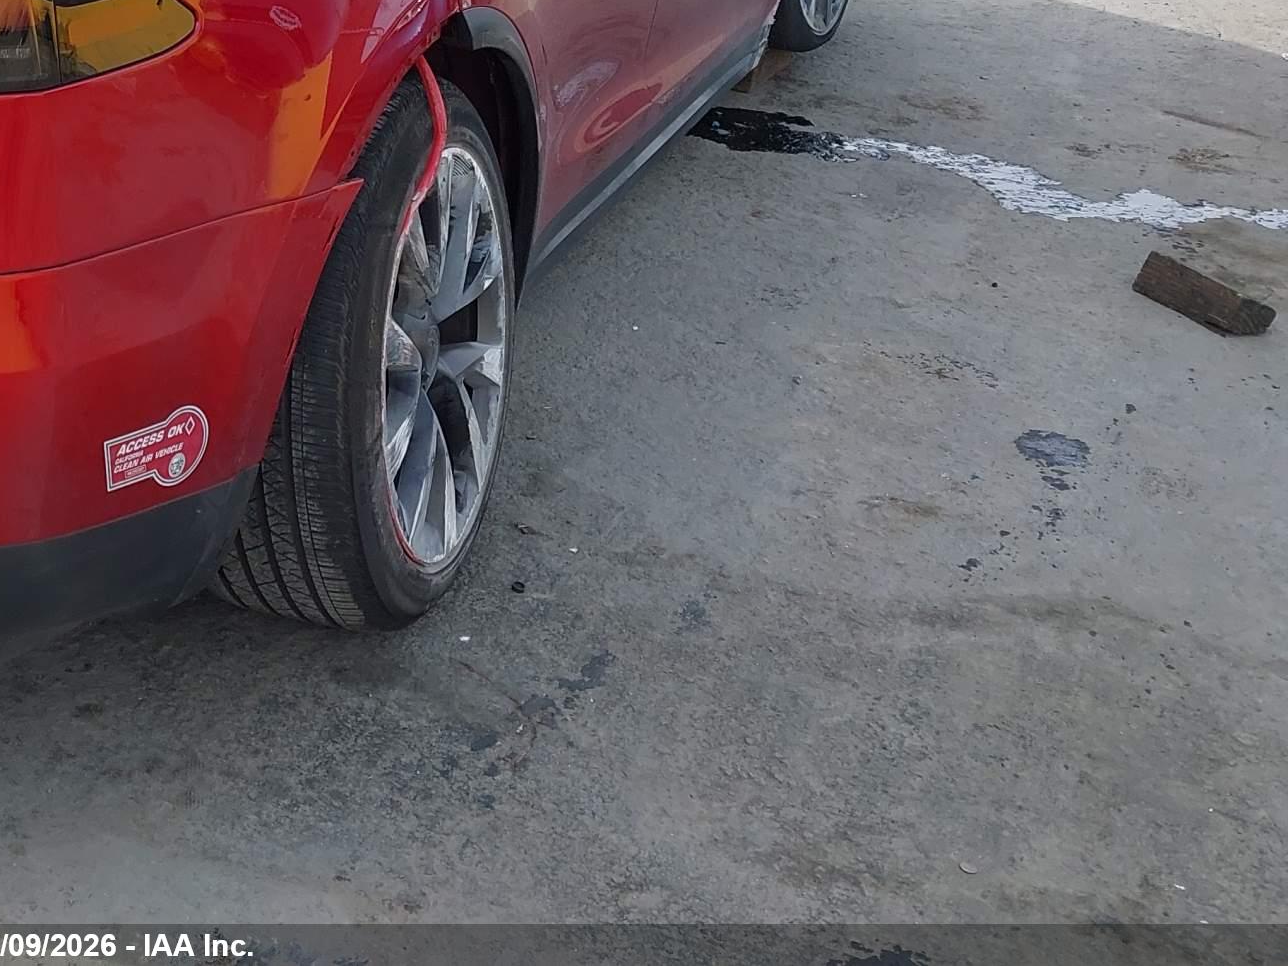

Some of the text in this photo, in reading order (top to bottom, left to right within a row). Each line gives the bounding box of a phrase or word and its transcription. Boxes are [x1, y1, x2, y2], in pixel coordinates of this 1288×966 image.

[116, 422, 186, 456] ACCESS OK
[114, 458, 140, 474] CLEAN
[140, 453, 154, 465] AIR
[155, 442, 185, 459] VEHICLE
